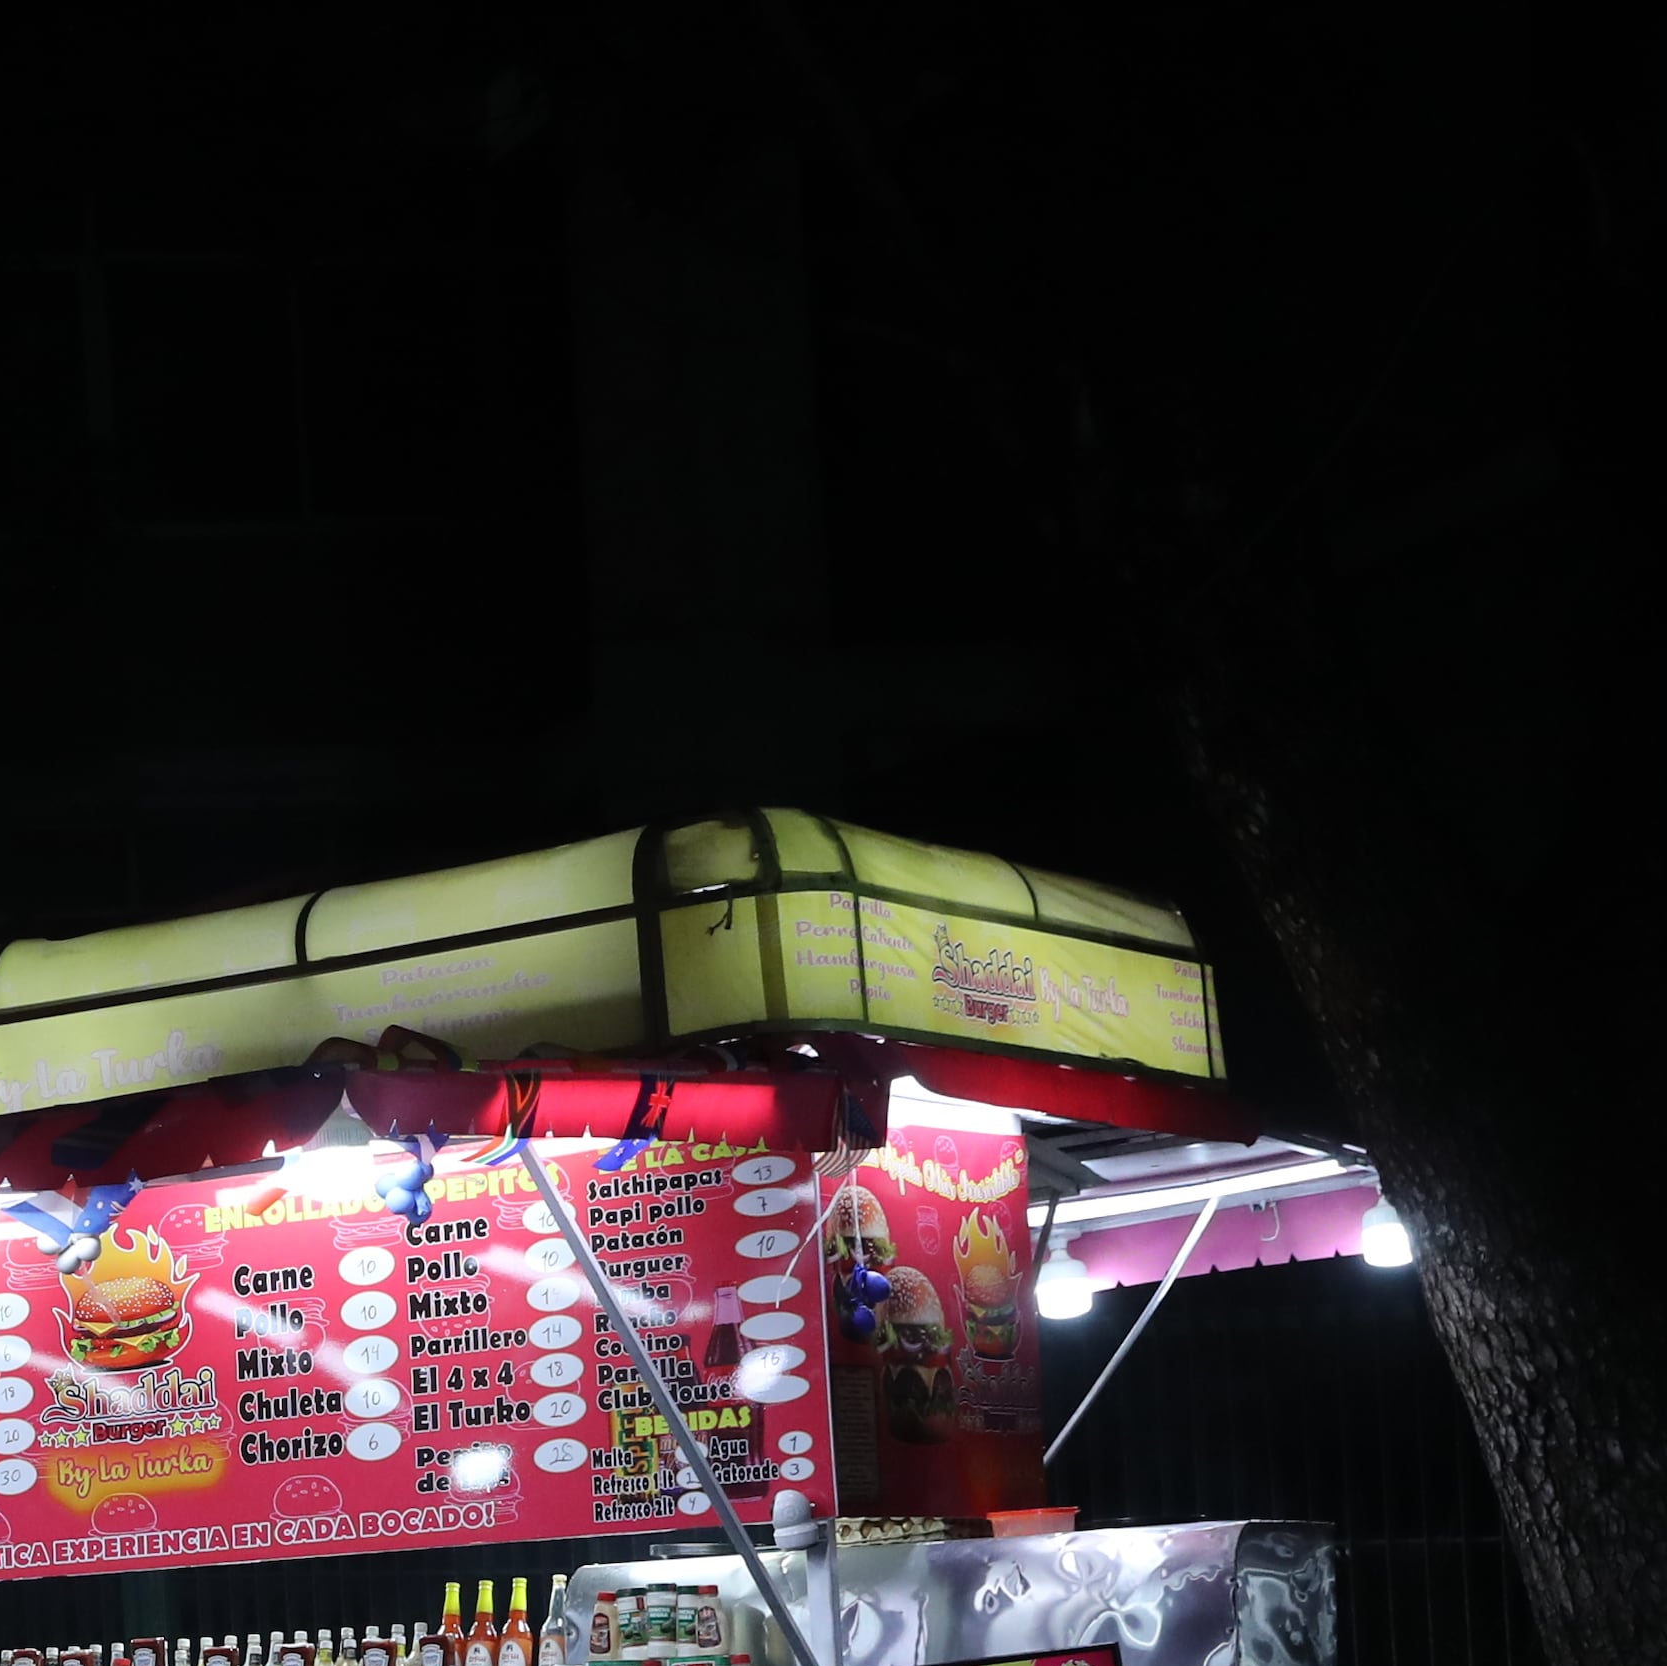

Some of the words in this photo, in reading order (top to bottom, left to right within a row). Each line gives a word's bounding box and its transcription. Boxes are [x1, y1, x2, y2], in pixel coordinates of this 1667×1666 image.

[932, 943, 1036, 1000] Shaddai
[964, 994, 1009, 1023] Burger
[91, 1029, 223, 1089] Turka
[587, 1169, 722, 1201] Salchipapas
[589, 1203, 641, 1227] Papi
[649, 1195, 706, 1219] pollo
[405, 1216, 489, 1247] Carne
[591, 1226, 684, 1253] Patacón
[233, 1265, 315, 1296] Carne
[406, 1251, 480, 1283] Pollo
[234, 1303, 305, 1339] Pollo
[408, 1290, 489, 1322] Mixto
[410, 1327, 527, 1359] Parrillero
[236, 1348, 314, 1381] Mixto
[411, 1365, 439, 1397] El
[447, 1366, 463, 1391] 4
[496, 1360, 515, 1386] 4
[41, 1367, 216, 1423] Shaddai
[238, 1389, 343, 1424] Chuleta
[598, 1389, 653, 1413] Club
[413, 1400, 439, 1433] El
[447, 1396, 533, 1429] Turko
[92, 1416, 167, 1446] Burger
[239, 1428, 345, 1465] Chorizo
[368, 1432, 379, 1451] 6
[592, 1447, 635, 1470] Malta
[709, 1438, 749, 1460] Agua
[58, 1458, 94, 1498] By
[99, 1454, 129, 1482] La
[133, 1445, 213, 1479] Turka
[593, 1474, 651, 1497] Refresco
[593, 1501, 652, 1523] Refresco
[52, 1525, 230, 1566] EXPERIENCIA
[231, 1521, 272, 1549] EN
[273, 1514, 357, 1545] CADA
[360, 1502, 497, 1538] BOCADO!
